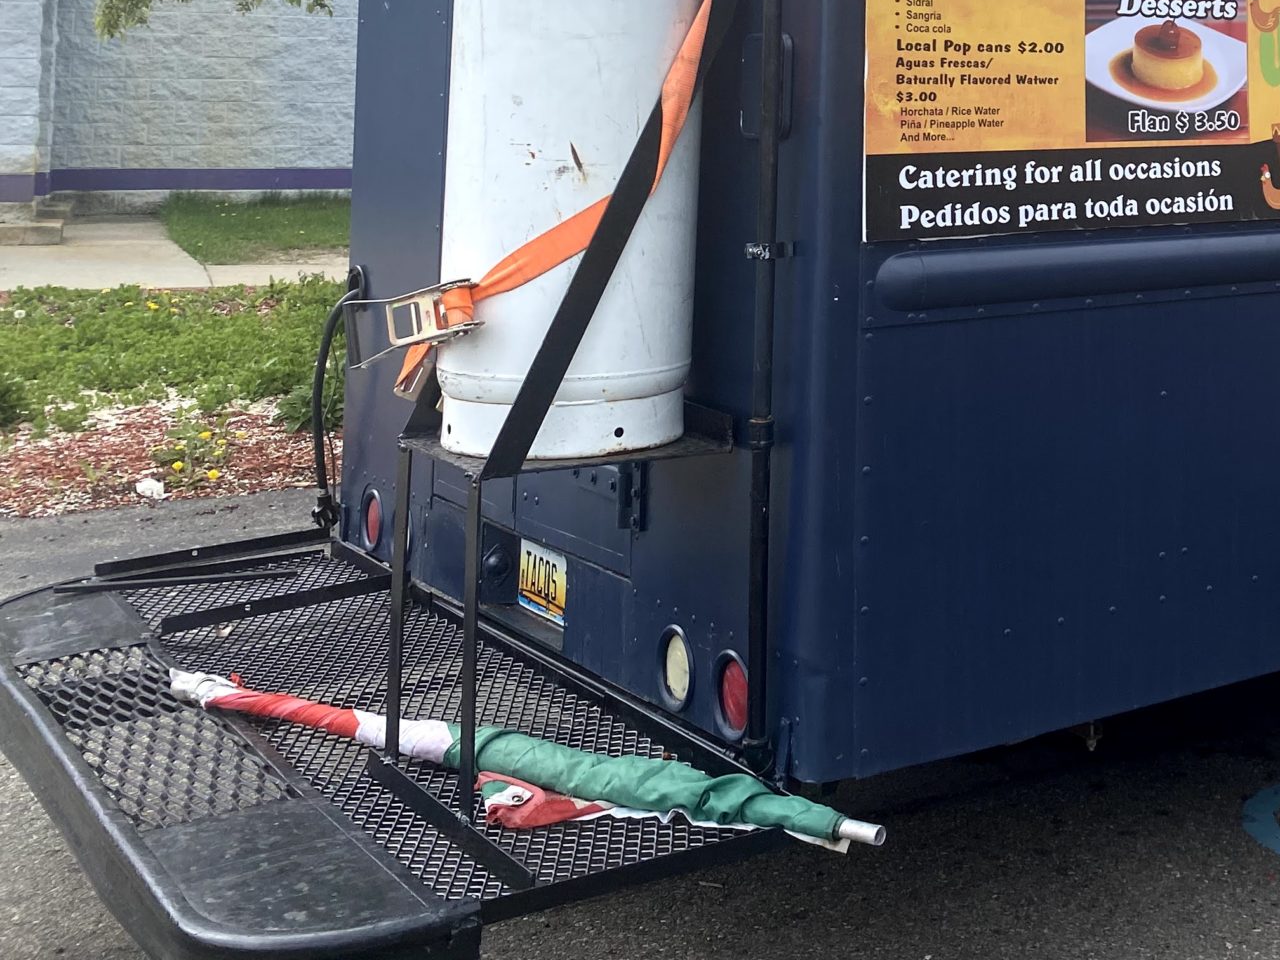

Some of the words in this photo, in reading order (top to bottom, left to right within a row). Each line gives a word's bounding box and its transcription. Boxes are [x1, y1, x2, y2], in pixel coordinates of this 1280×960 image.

[906, 10, 941, 22] Sangria
[906, 23, 929, 33] Coca
[932, 24, 951, 34] cola
[897, 39, 936, 52] Local
[944, 40, 971, 55] Pop
[977, 43, 1011, 53] cans
[1018, 41, 1064, 54] $2.00
[896, 57, 935, 70] Aguas
[896, 74, 955, 87] Baturally
[960, 74, 1011, 85] Flavored
[1016, 74, 1059, 85] Watwer
[896, 91, 937, 103] $3.00
[901, 107, 943, 116] Horchata
[951, 106, 971, 115] Rice
[975, 107, 1000, 115] Water
[901, 119, 921, 128] Piña
[930, 119, 975, 130] Pineapple
[978, 119, 1004, 127] Water
[1129, 110, 1169, 132] Flan
[900, 133, 920, 141] And
[899, 164, 1017, 190] Catering
[1024, 161, 1063, 185] for
[1069, 159, 1102, 183] all
[1109, 158, 1221, 180] occasions
[900, 201, 1010, 229] Pedidos
[1018, 198, 1077, 226] para
[1084, 195, 1138, 219] toda
[1146, 189, 1234, 215] ocasión
[526, 550, 557, 601] TACOS
